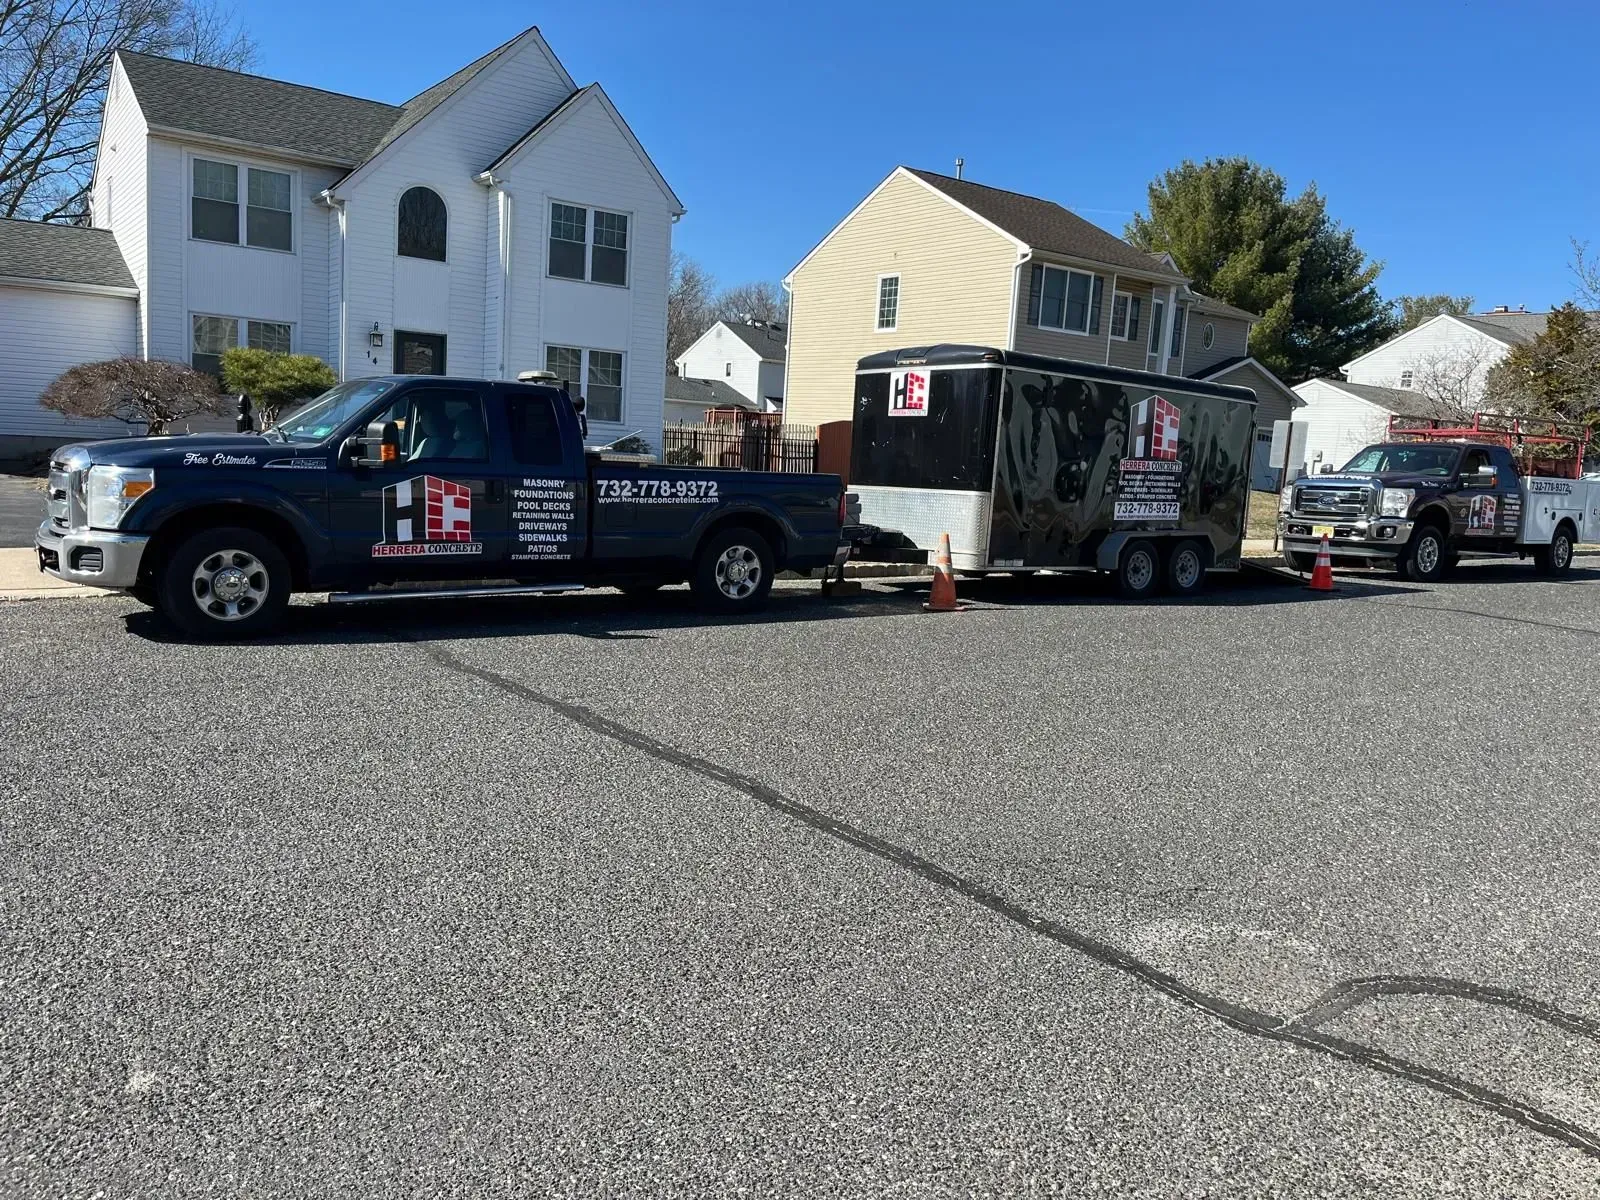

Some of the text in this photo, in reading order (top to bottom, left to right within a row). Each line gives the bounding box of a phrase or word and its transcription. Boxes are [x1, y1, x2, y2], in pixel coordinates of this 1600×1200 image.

[183, 453, 257, 467] Free Estimates
[1120, 461, 1181, 471] HERRERA CONCRETE
[523, 479, 565, 488] MASONRY
[597, 480, 718, 497] 732-778-9372
[514, 490, 574, 500] FOUNDATIONS
[597, 496, 719, 504] www.herreraconcreteinc.com
[517, 501, 571, 511] POOL DECKS
[1117, 503, 1178, 514] 732-778-9372
[551, 512, 574, 520] WALLS
[519, 522, 567, 531] DRIVEWAYS
[518, 533, 567, 542] SIDEWALKS
[373, 543, 482, 556] HERRERA CONCRETE
[527, 545, 558, 553] PATIOS
